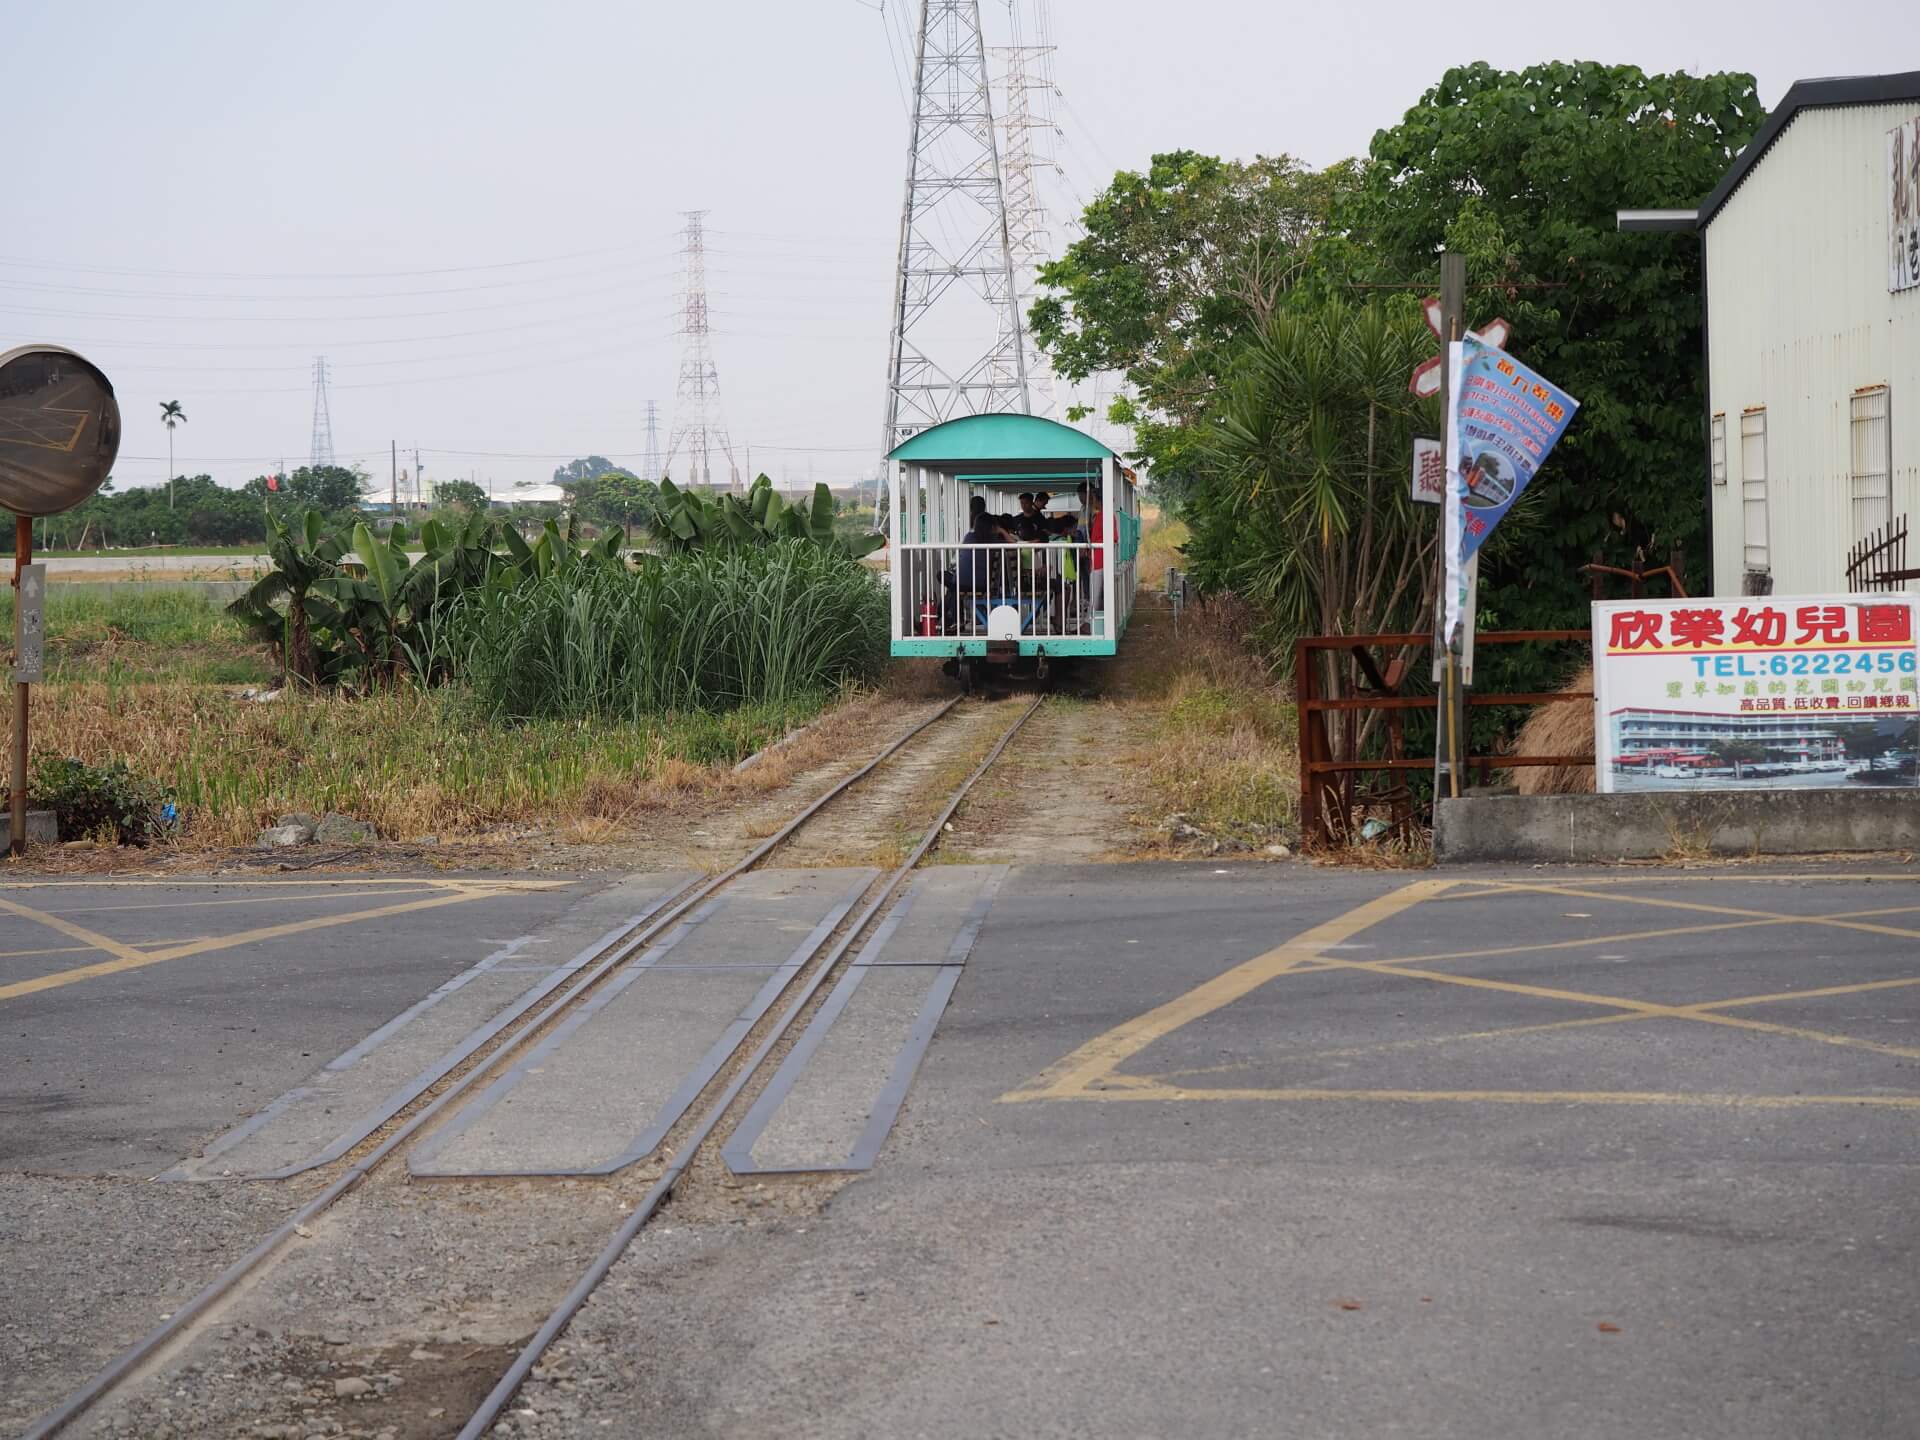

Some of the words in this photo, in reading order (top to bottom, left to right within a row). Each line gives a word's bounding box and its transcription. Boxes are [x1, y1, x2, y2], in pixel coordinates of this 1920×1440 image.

[1609, 605, 1912, 649] 欣榮幼兒園
[1691, 652, 1916, 677] TEL:6222456
